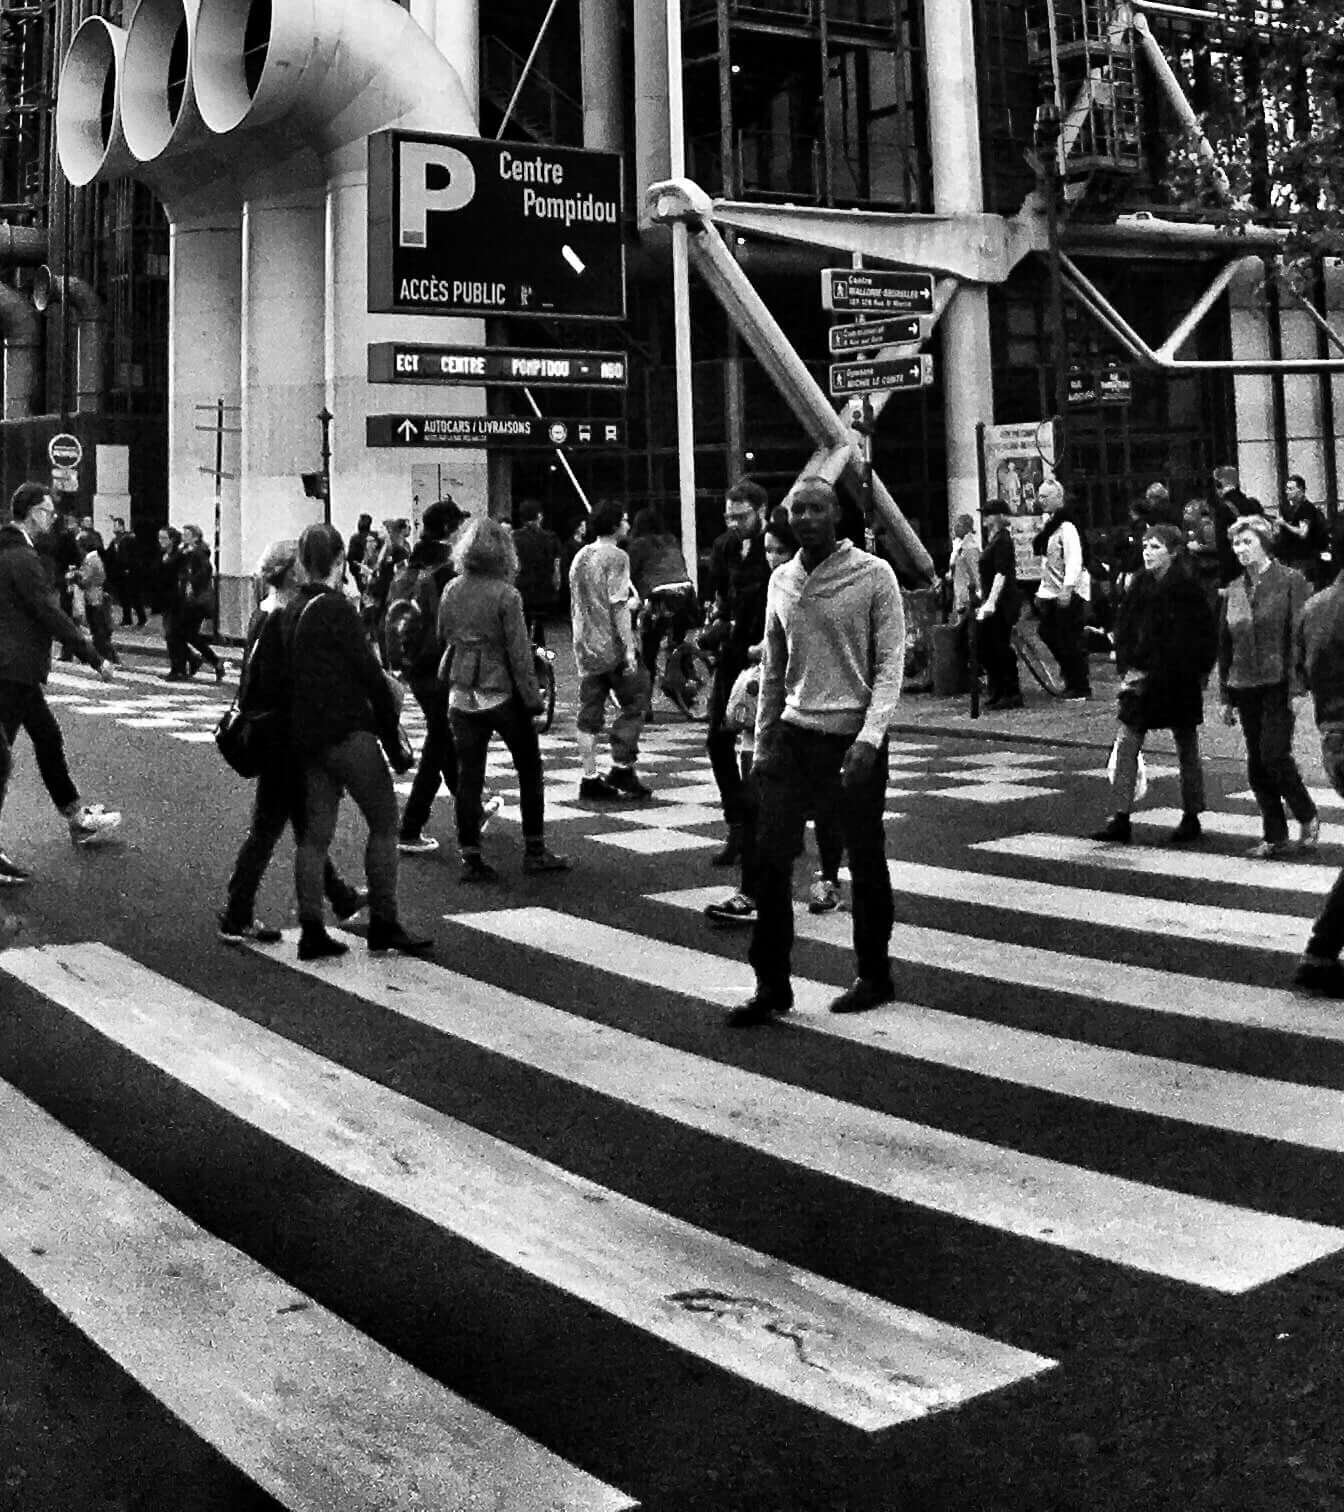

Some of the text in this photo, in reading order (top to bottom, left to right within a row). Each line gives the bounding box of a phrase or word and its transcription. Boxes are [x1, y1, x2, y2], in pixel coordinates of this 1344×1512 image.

[499, 150, 564, 185] Centre
[399, 141, 476, 249] P
[523, 188, 616, 226] Pompidou
[399, 275, 506, 305] ACCÈS PUBLIC
[396, 353, 419, 373] ECT
[440, 356, 487, 375] CENTRE
[511, 358, 570, 377] POMPIDOU
[424, 419, 471, 434] AUTOCARS
[478, 420, 531, 435] LIVRAISONS
